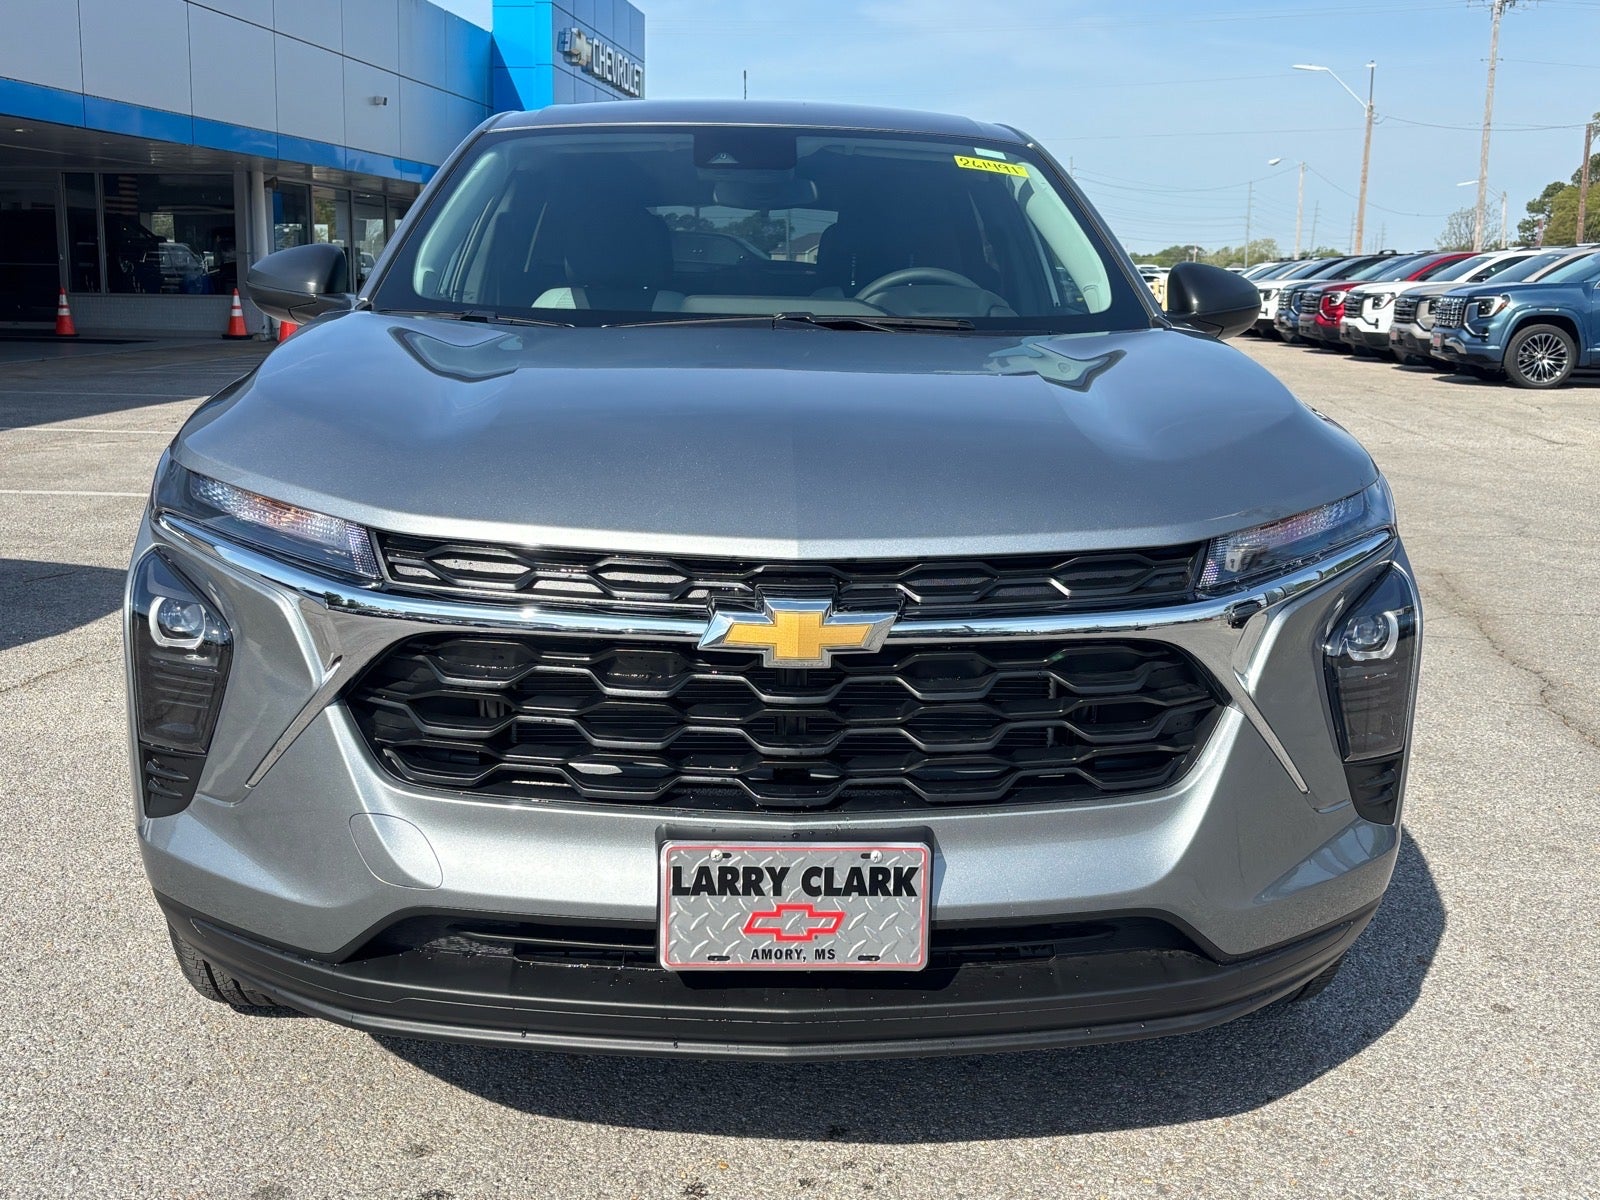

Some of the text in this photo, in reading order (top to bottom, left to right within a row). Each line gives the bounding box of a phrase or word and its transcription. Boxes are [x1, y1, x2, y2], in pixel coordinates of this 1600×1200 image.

[592, 38, 643, 96] CHEVROLET
[672, 866, 918, 897] LARRY CLARK
[751, 949, 836, 962] AMORY, MS
